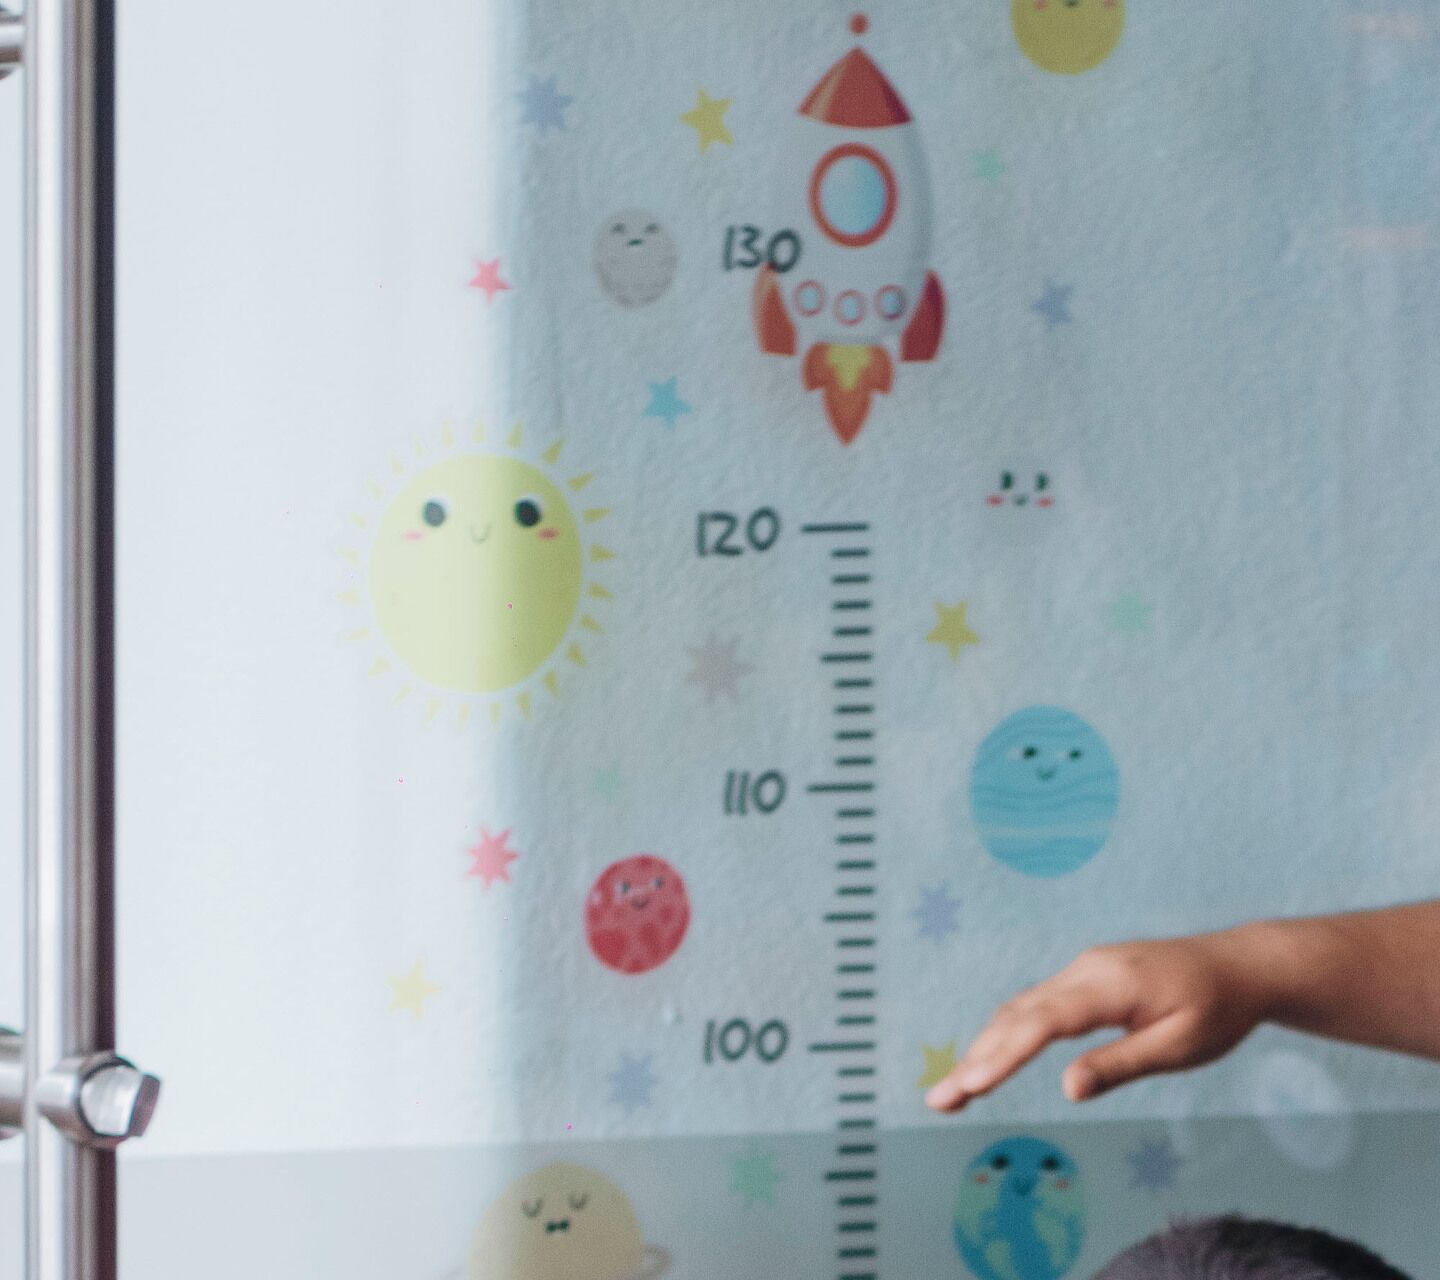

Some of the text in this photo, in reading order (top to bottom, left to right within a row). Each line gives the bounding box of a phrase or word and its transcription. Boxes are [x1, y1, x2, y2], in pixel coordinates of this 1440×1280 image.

[722, 225, 802, 274] 130
[698, 507, 782, 557] 120
[723, 769, 787, 815] 110
[703, 1018, 790, 1064] 100
